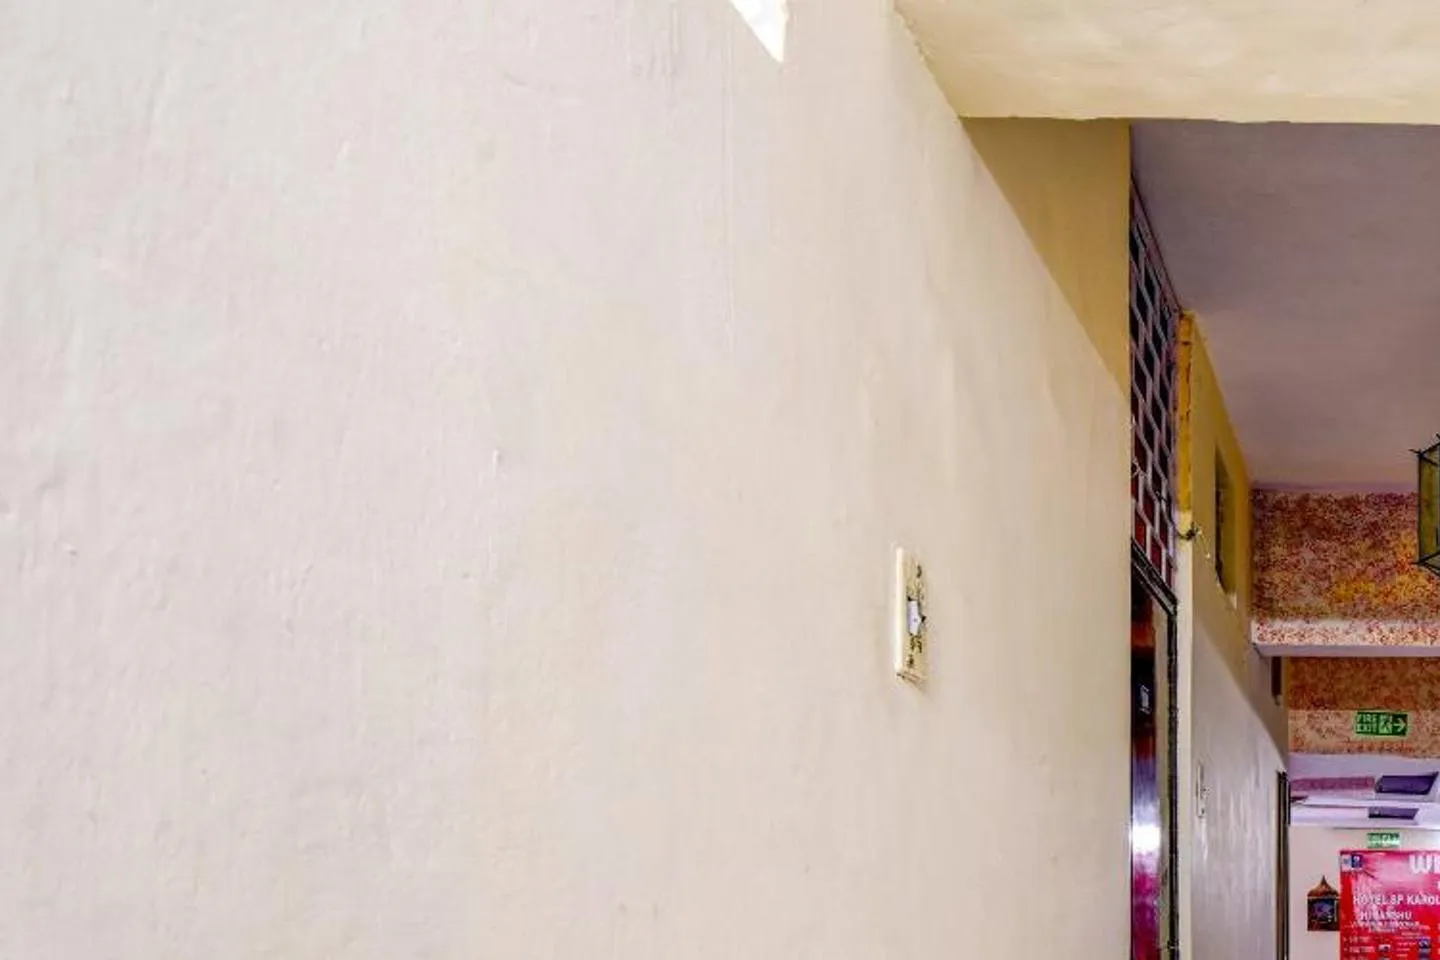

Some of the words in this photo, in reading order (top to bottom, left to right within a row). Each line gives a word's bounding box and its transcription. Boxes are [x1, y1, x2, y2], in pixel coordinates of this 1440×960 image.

[1356, 714, 1378, 723] FIRE
[1356, 723, 1378, 732] EXIT
[1353, 894, 1387, 905] HOTEL
